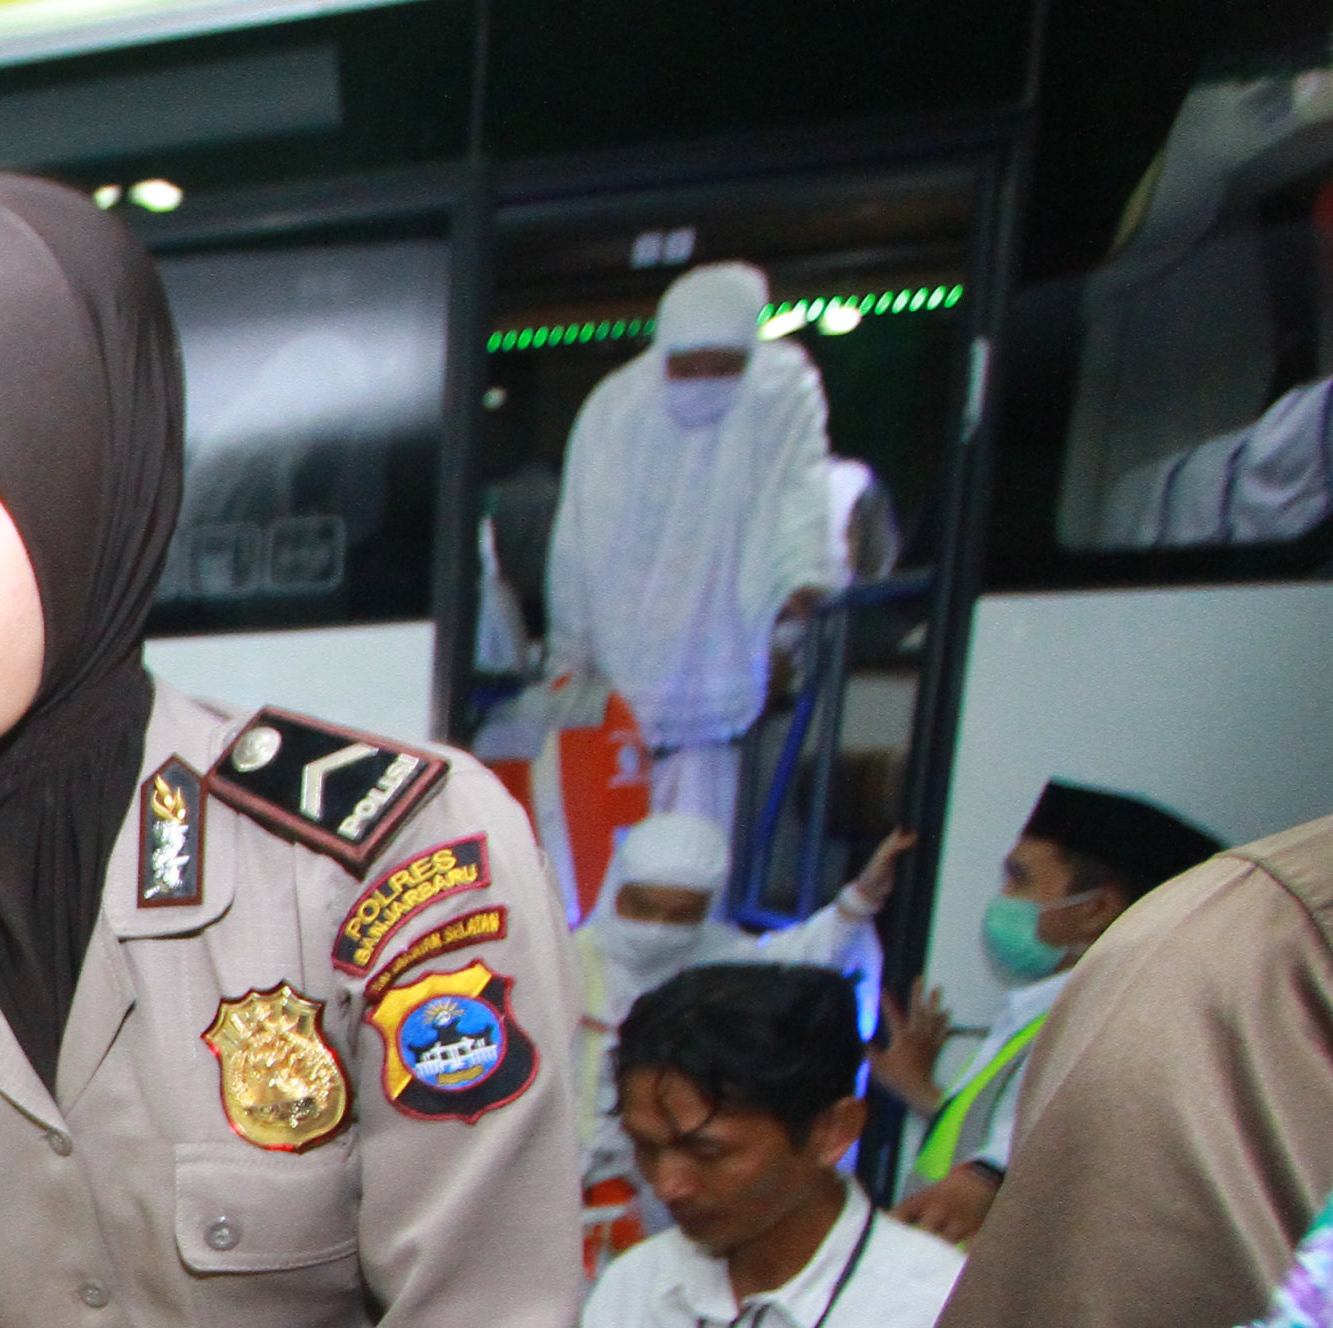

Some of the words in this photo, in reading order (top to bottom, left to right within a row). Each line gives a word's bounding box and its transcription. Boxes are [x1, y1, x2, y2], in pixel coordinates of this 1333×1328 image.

[337, 752, 419, 841] POLISI
[344, 848, 457, 940] POLRES
[353, 863, 478, 966] BANJARBARU
